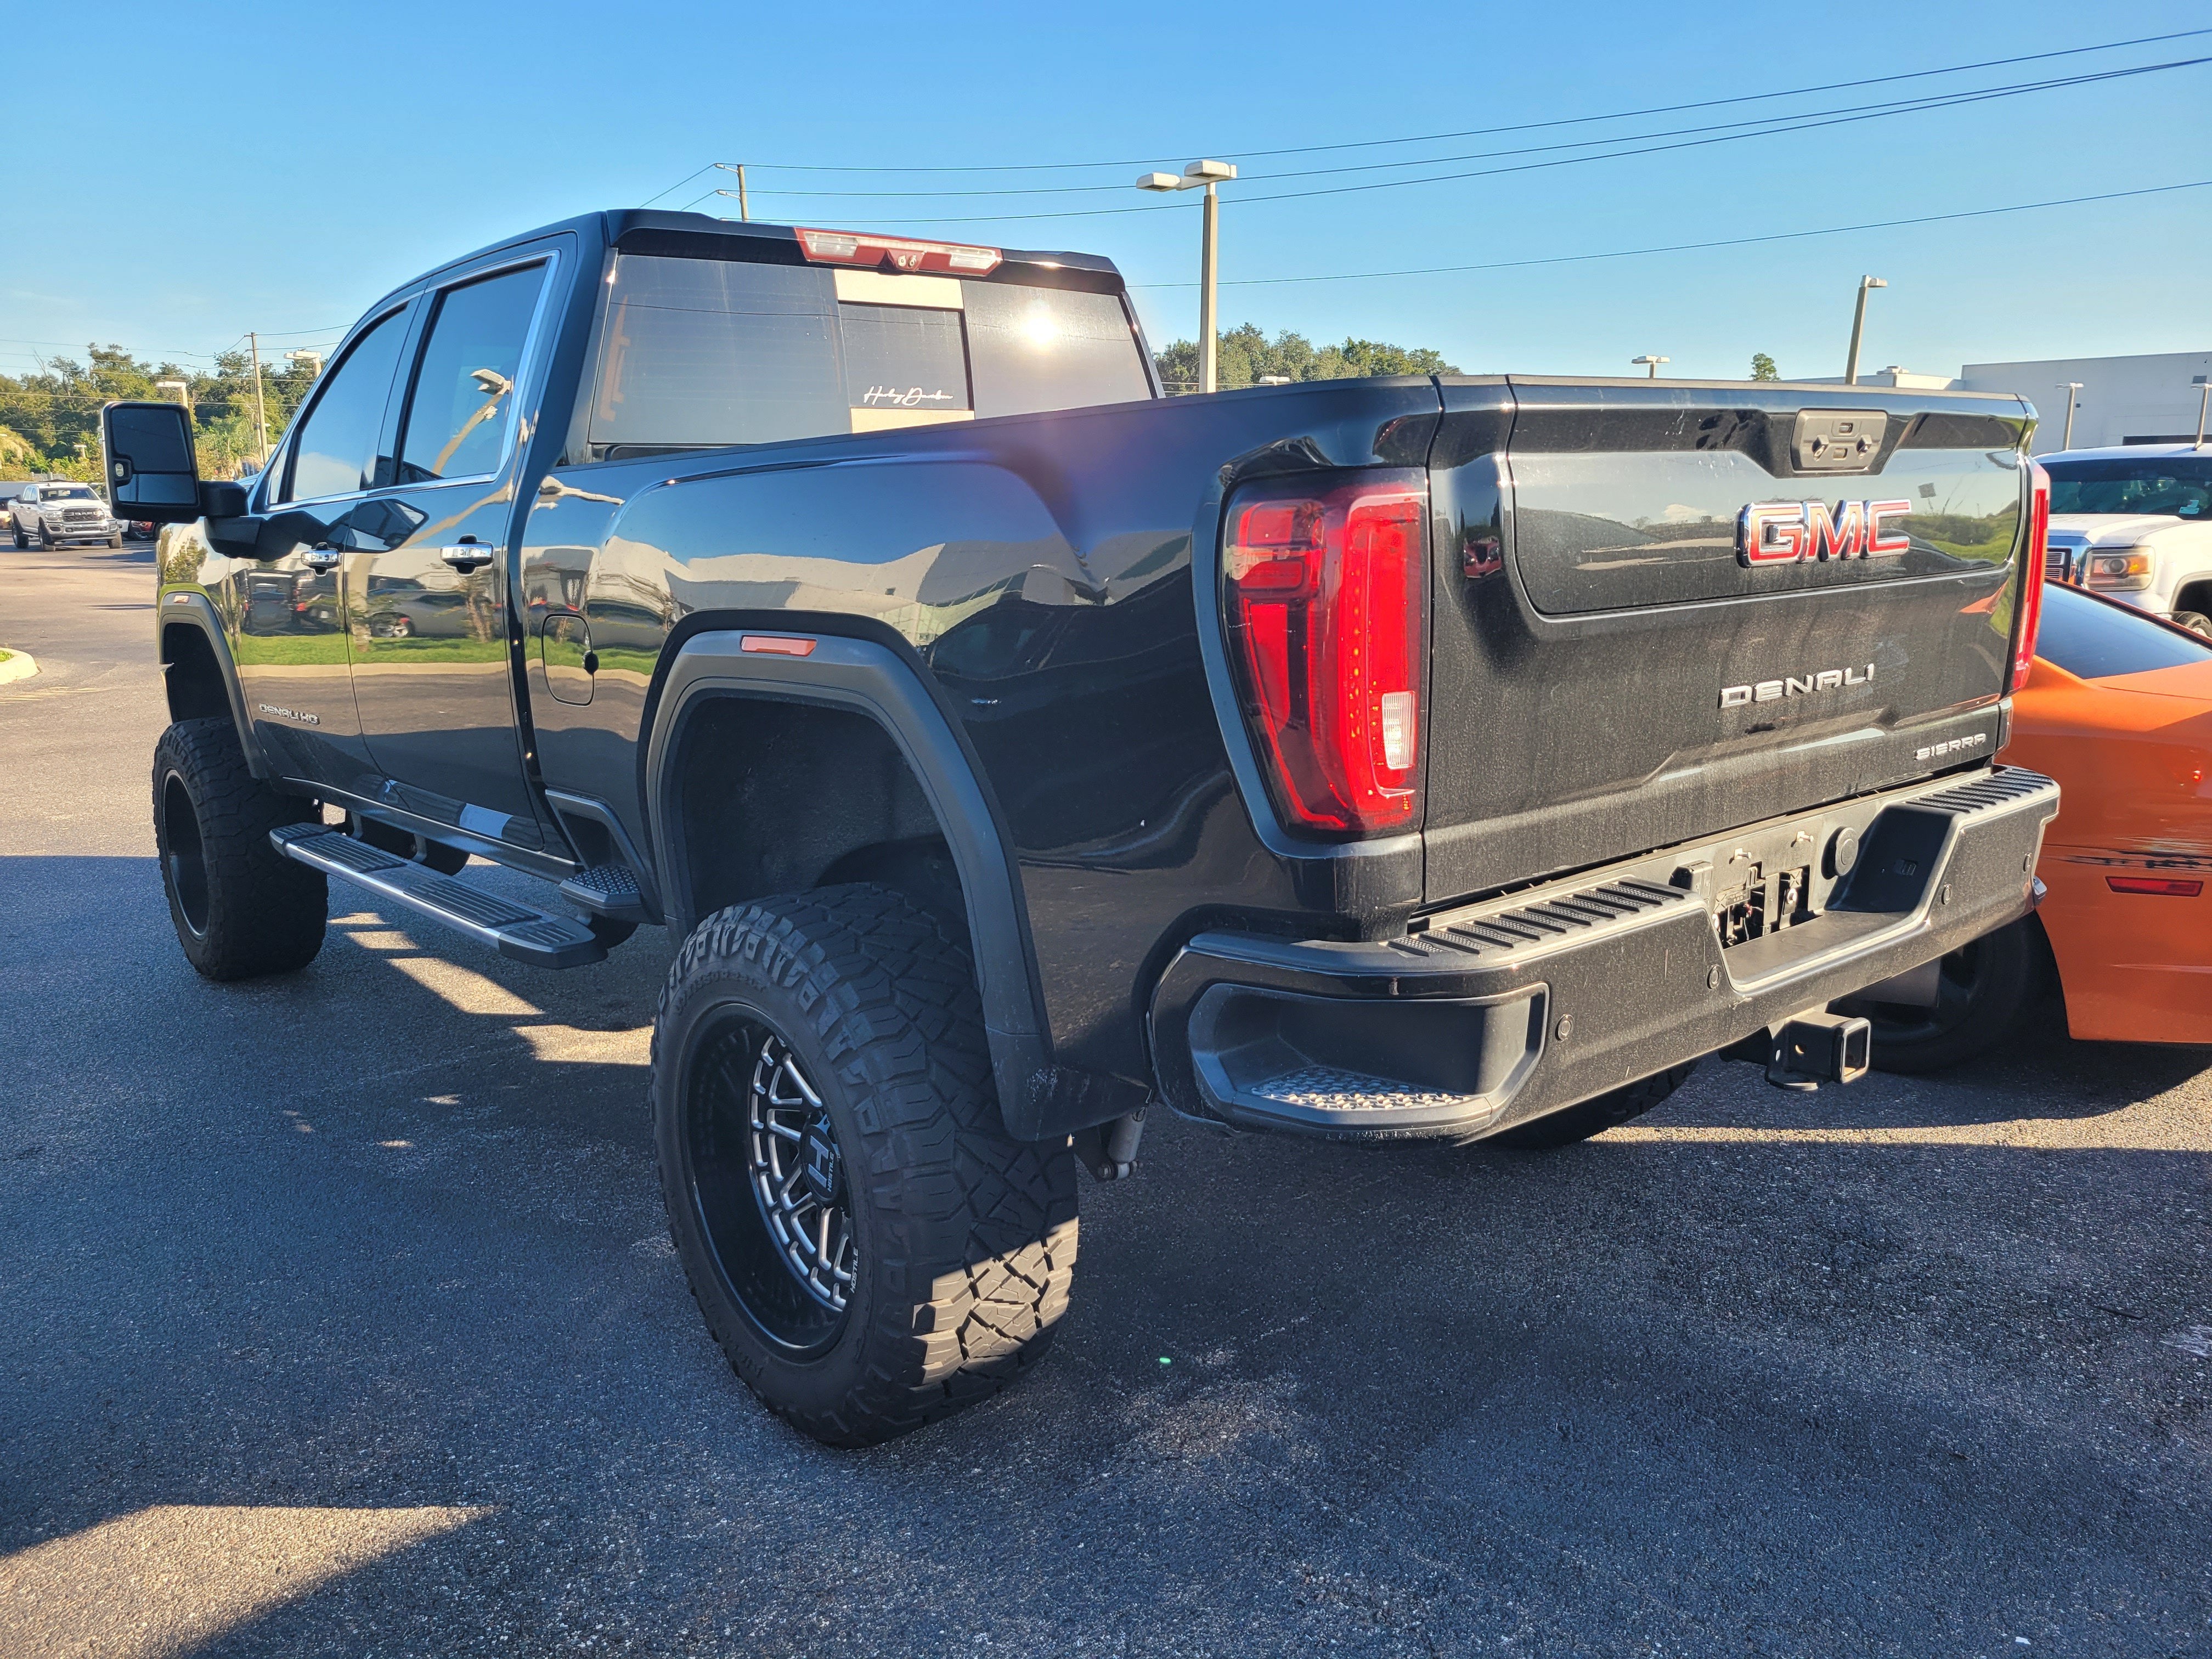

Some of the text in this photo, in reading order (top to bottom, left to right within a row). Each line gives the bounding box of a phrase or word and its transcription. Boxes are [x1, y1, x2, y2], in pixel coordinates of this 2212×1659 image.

[1736, 499, 1912, 568] GMC
[1718, 663, 1874, 709] DENALI
[259, 703, 320, 725] DENALI HD
[1914, 733, 1987, 761] SIERRA
[850, 1246, 859, 1293] HOSTILE
